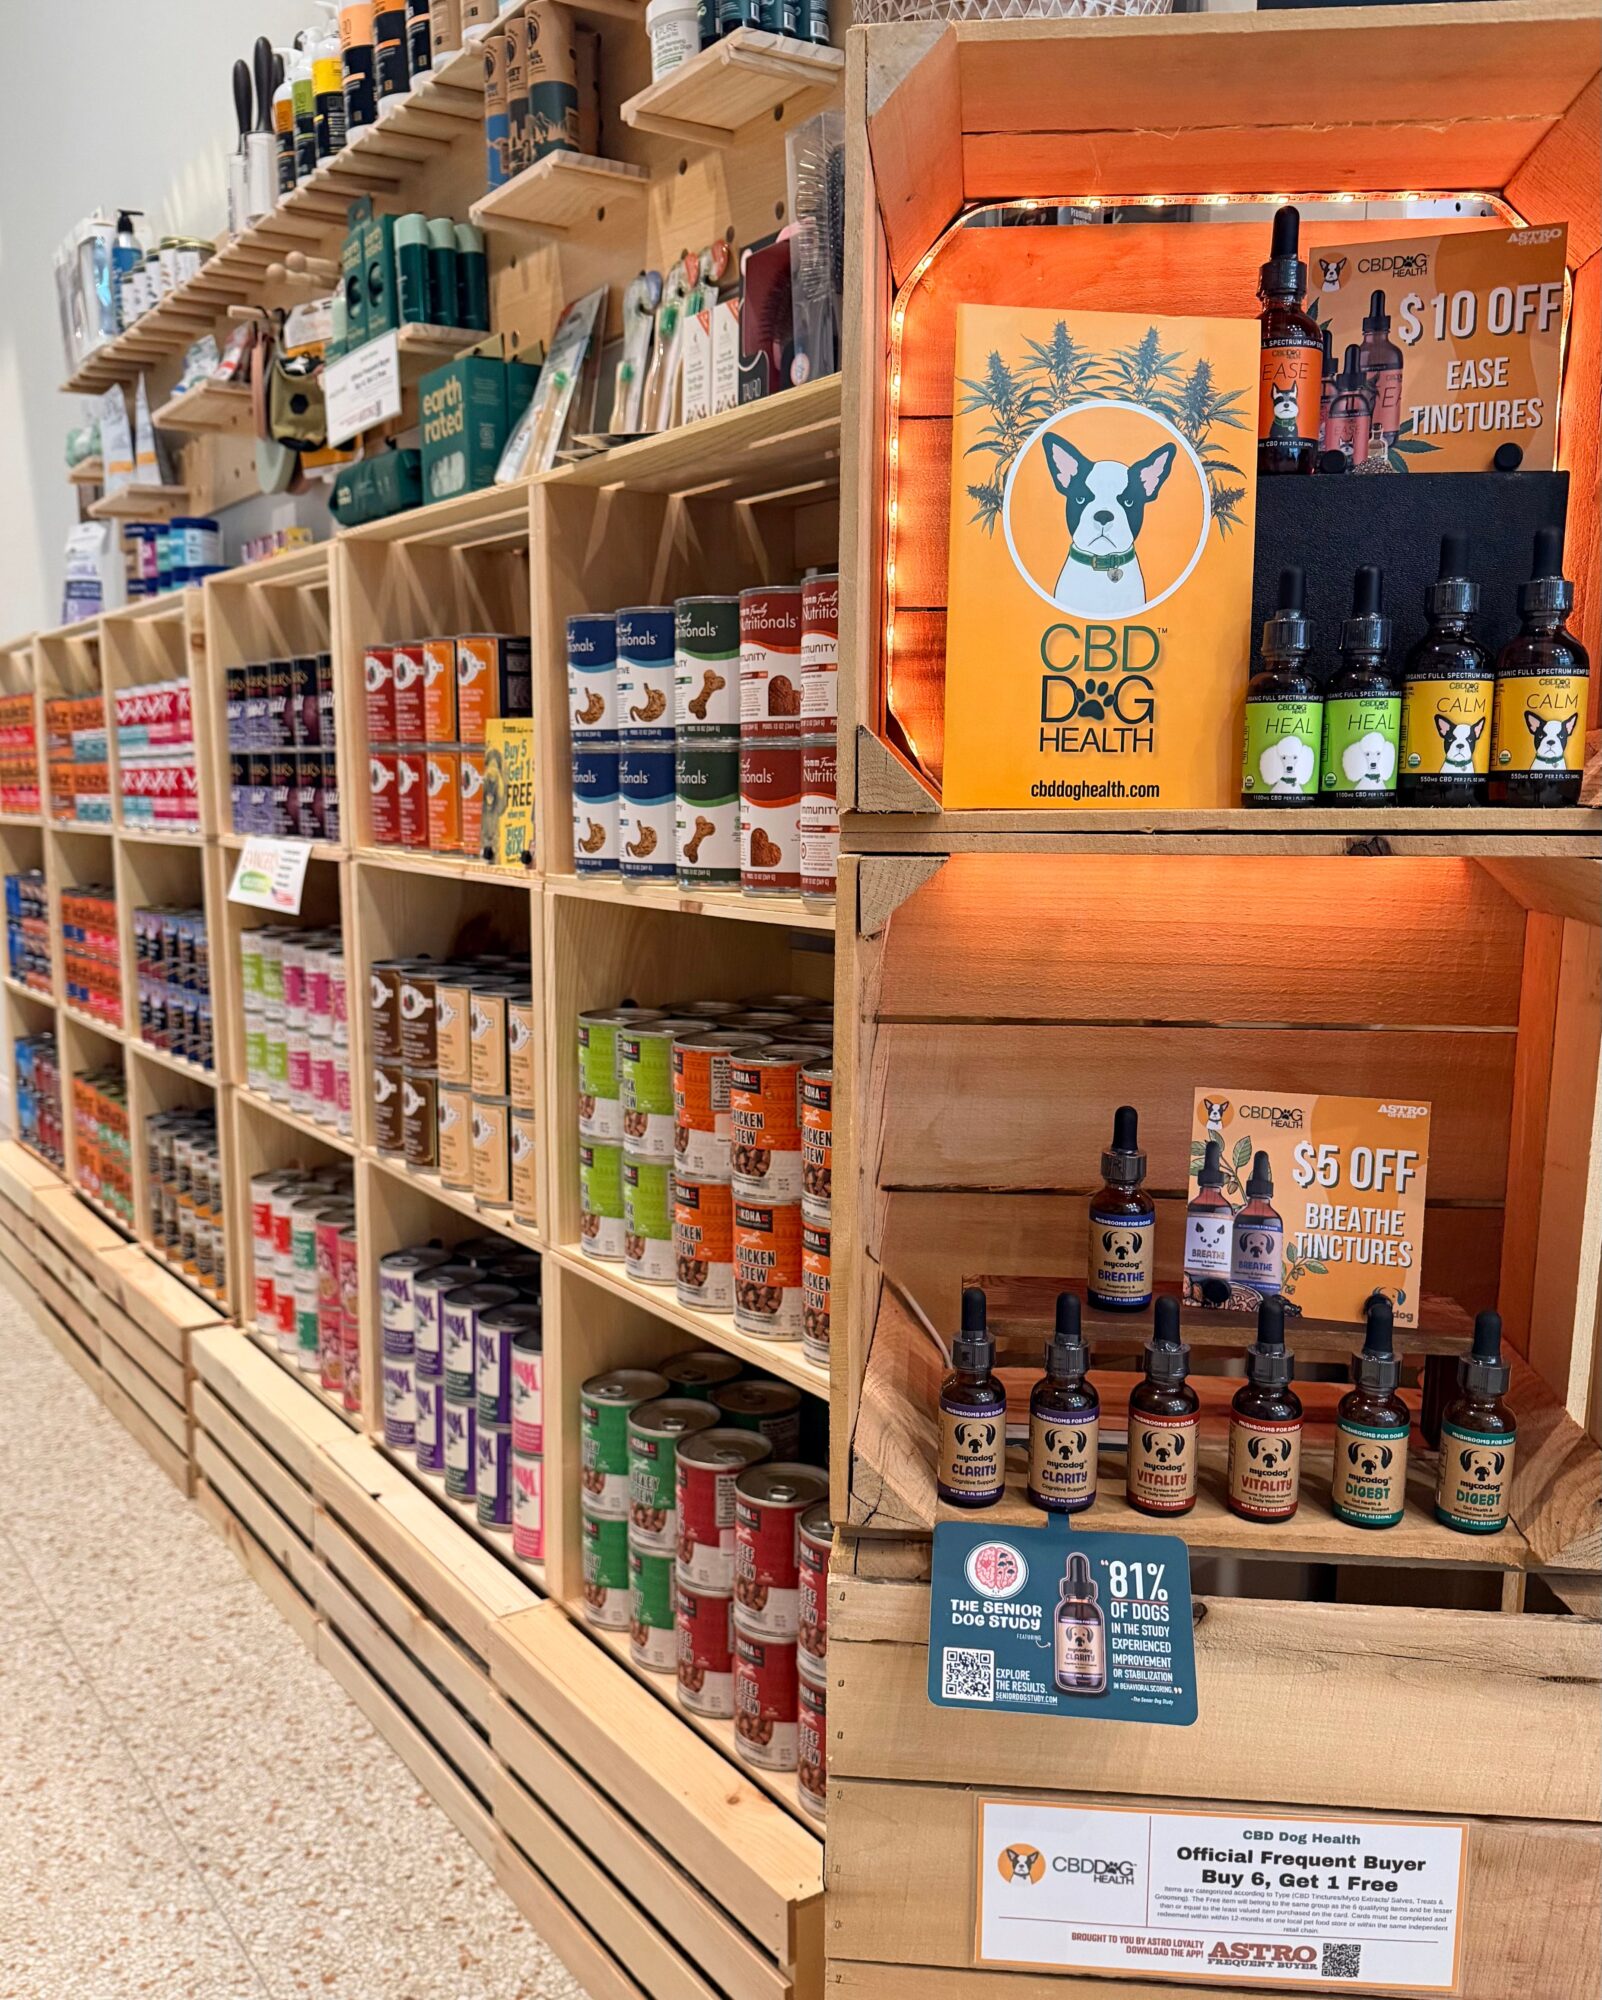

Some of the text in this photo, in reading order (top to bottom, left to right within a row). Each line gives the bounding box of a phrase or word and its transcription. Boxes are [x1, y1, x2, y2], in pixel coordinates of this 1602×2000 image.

[1507, 229, 1562, 243] ASTRO
[1392, 267, 1427, 278] HEALTH
[1398, 281, 1563, 343] $10 OFF
[1269, 339, 1302, 347] SPECTRUM
[1262, 362, 1310, 381] EASE
[1446, 357, 1509, 391] EASE
[423, 375, 463, 416] earth
[425, 402, 464, 444] rated
[1409, 398, 1544, 436] TINCTURES
[1040, 623, 1160, 672] CBD
[1436, 697, 1486, 713] CALM
[1526, 693, 1579, 709] CALM
[1266, 717, 1313, 734] HEAL
[1348, 714, 1395, 730] HEAL
[1040, 727, 1153, 752] HEALTH
[504, 739, 528, 763] Buy 5
[508, 758, 531, 781] Get 1
[507, 783, 533, 807] FREE
[1031, 780, 1160, 801] cbddoghealth.com
[1377, 1104, 1428, 1116] ASTRO
[733, 1109, 764, 1129] HICKEN
[1271, 1120, 1303, 1129] HEALTH
[1292, 1140, 1418, 1193] $5 OFF
[1304, 1202, 1406, 1237] BREATHE
[736, 1245, 776, 1266] CHICKEN
[1191, 1249, 1225, 1260] BREATHE
[1294, 1232, 1413, 1268] TINCTURES
[1103, 1261, 1140, 1270] mycodog
[1238, 1260, 1273, 1272] BREATHE
[740, 1267, 767, 1283] STEW
[1097, 1269, 1145, 1283] BREATHE
[956, 1454, 994, 1463] mycodog
[1046, 1460, 1085, 1470] mycodog
[1143, 1461, 1182, 1472] mycodog
[951, 1463, 997, 1477] CLARITY
[1042, 1469, 1088, 1484] CLARITY
[1137, 1469, 1187, 1486] VITALITY
[1249, 1467, 1288, 1477] mycodog
[1241, 1475, 1292, 1492] VITALITY
[1348, 1473, 1389, 1486] mycodog
[1460, 1480, 1500, 1492] mycodog
[1345, 1482, 1391, 1500] DIGEST
[1456, 1488, 1502, 1506] DIGEST
[951, 1599, 1043, 1618] THE SENIOR
[1110, 1601, 1169, 1622] OF DOGS
[952, 1613, 1041, 1630] DOG STUDY
[1111, 1622, 1170, 1637] IN THE STUDY
[1016, 1633, 1042, 1641] FEATURING
[1112, 1638, 1172, 1653] EXPERIENCED
[1065, 1652, 1095, 1662] CLARITY
[1112, 1654, 1172, 1668] IMPROVEMENT
[996, 1668, 1031, 1681] EXPLORE
[1113, 1668, 1173, 1682] OR STABILIZATION
[996, 1680, 1048, 1694] THE RESULTS.
[1113, 1682, 1119, 1690] IN
[995, 1691, 1058, 1704] SENIORDOGSTUDY.COM
[1243, 1830, 1361, 1845] CBD Dog Health
[1177, 1847, 1427, 1874] Official Frequent Buyer
[1093, 1874, 1135, 1885] HEALTH
[1202, 1869, 1399, 1892] Buy 6, Get 1 Free
[1249, 1898, 1271, 1907] belong
[1311, 1903, 1330, 1911] group
[1071, 1932, 1204, 1949] BROUGHT TO YOU BY ASTRO LOYALTY
[1125, 1945, 1169, 1956] DOWNLOAD
[1170, 1947, 1185, 1957] THE
[1208, 1941, 1317, 1962] ASTRO
[1207, 1958, 1318, 1970] FREQUENT BUYER
